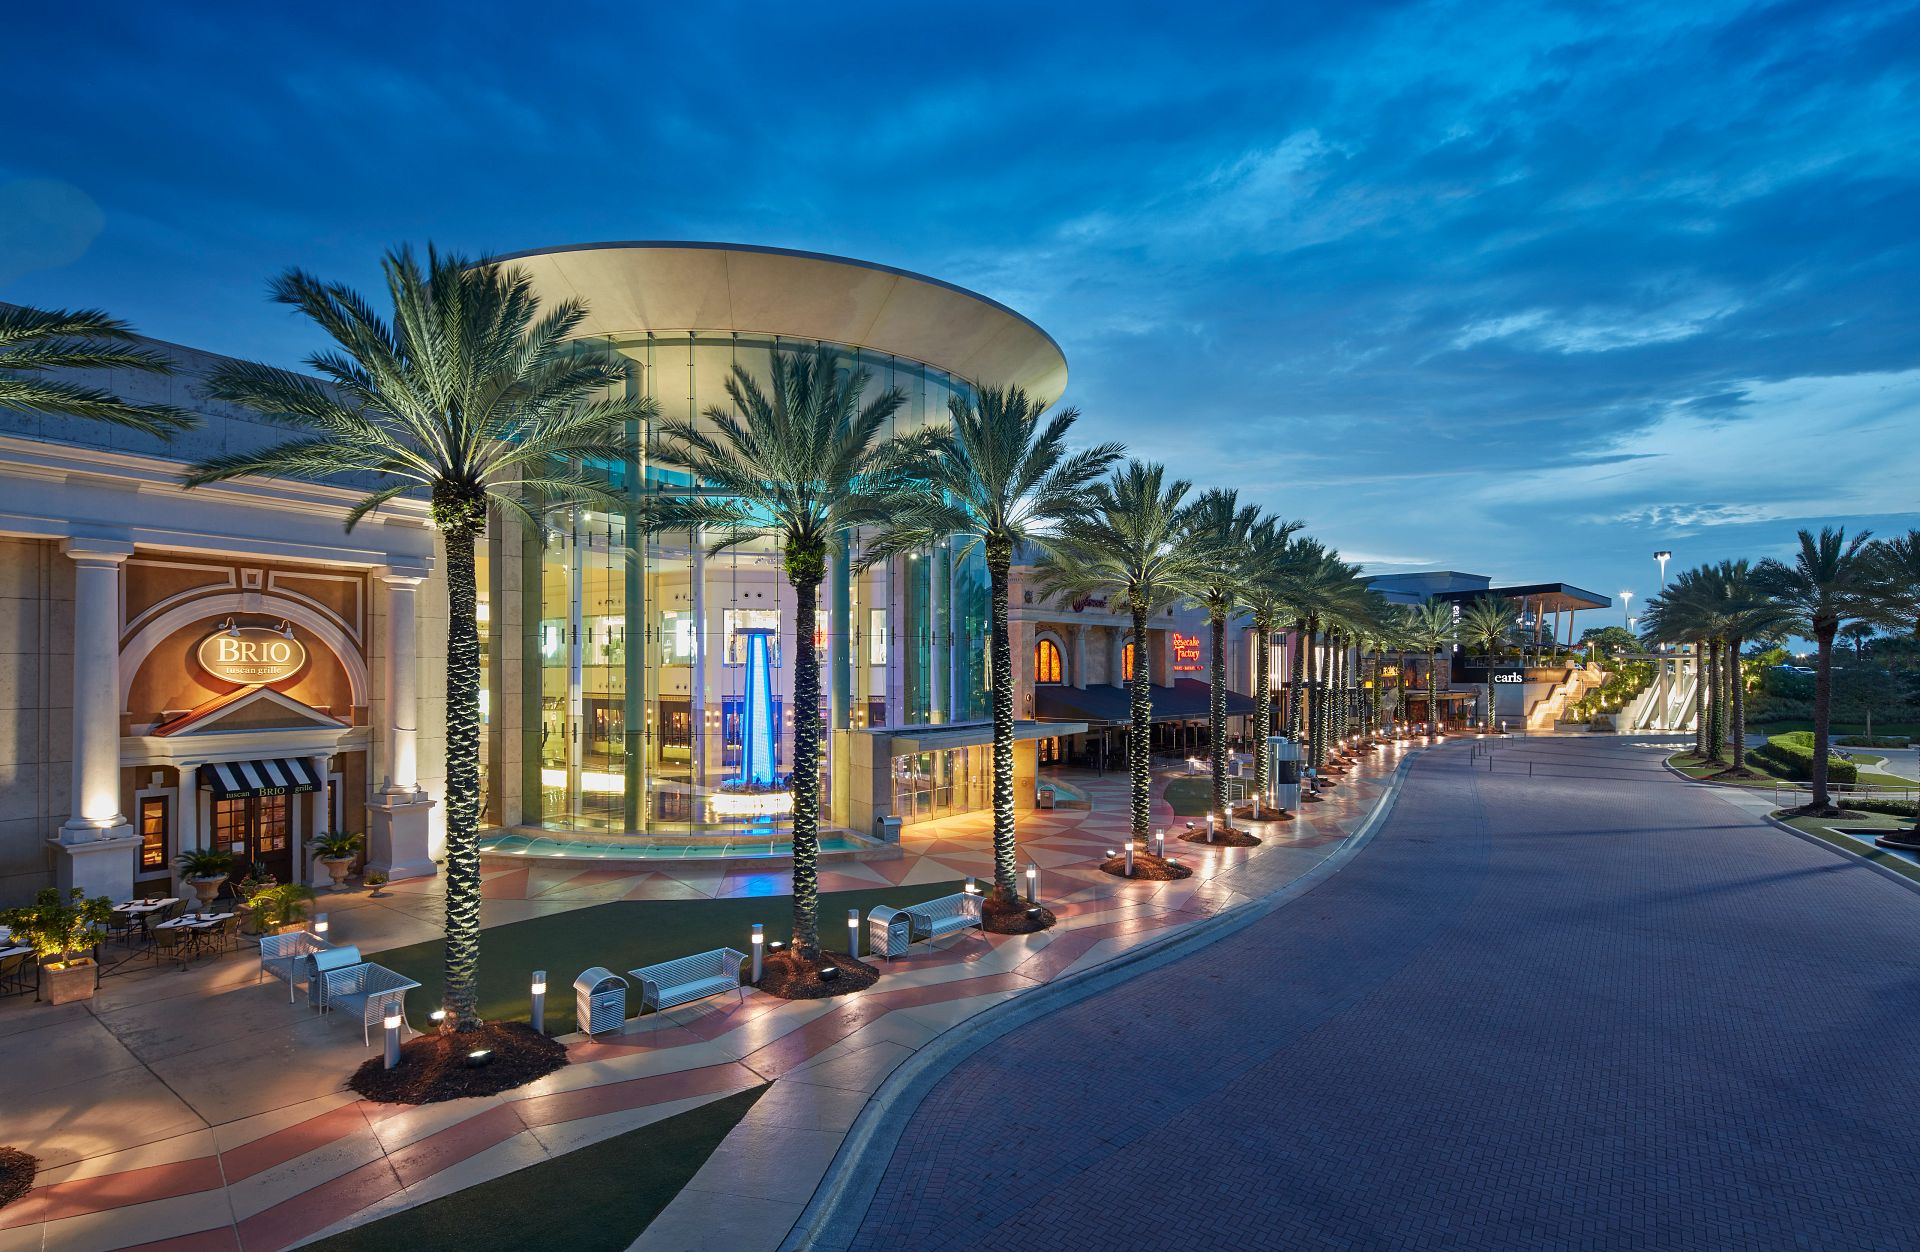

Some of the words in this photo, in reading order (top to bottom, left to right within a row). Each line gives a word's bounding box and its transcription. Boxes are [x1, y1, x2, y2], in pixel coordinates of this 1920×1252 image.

[1174, 635, 1200, 647] eesecake
[216, 638, 291, 663] BRIO
[1174, 645, 1200, 662] Factory
[225, 666, 256, 675] tuscan
[257, 665, 283, 676] grille
[1494, 671, 1523, 683] earls
[226, 791, 250, 799] tuscan
[259, 786, 286, 797] BRIO
[294, 784, 313, 794] grille
